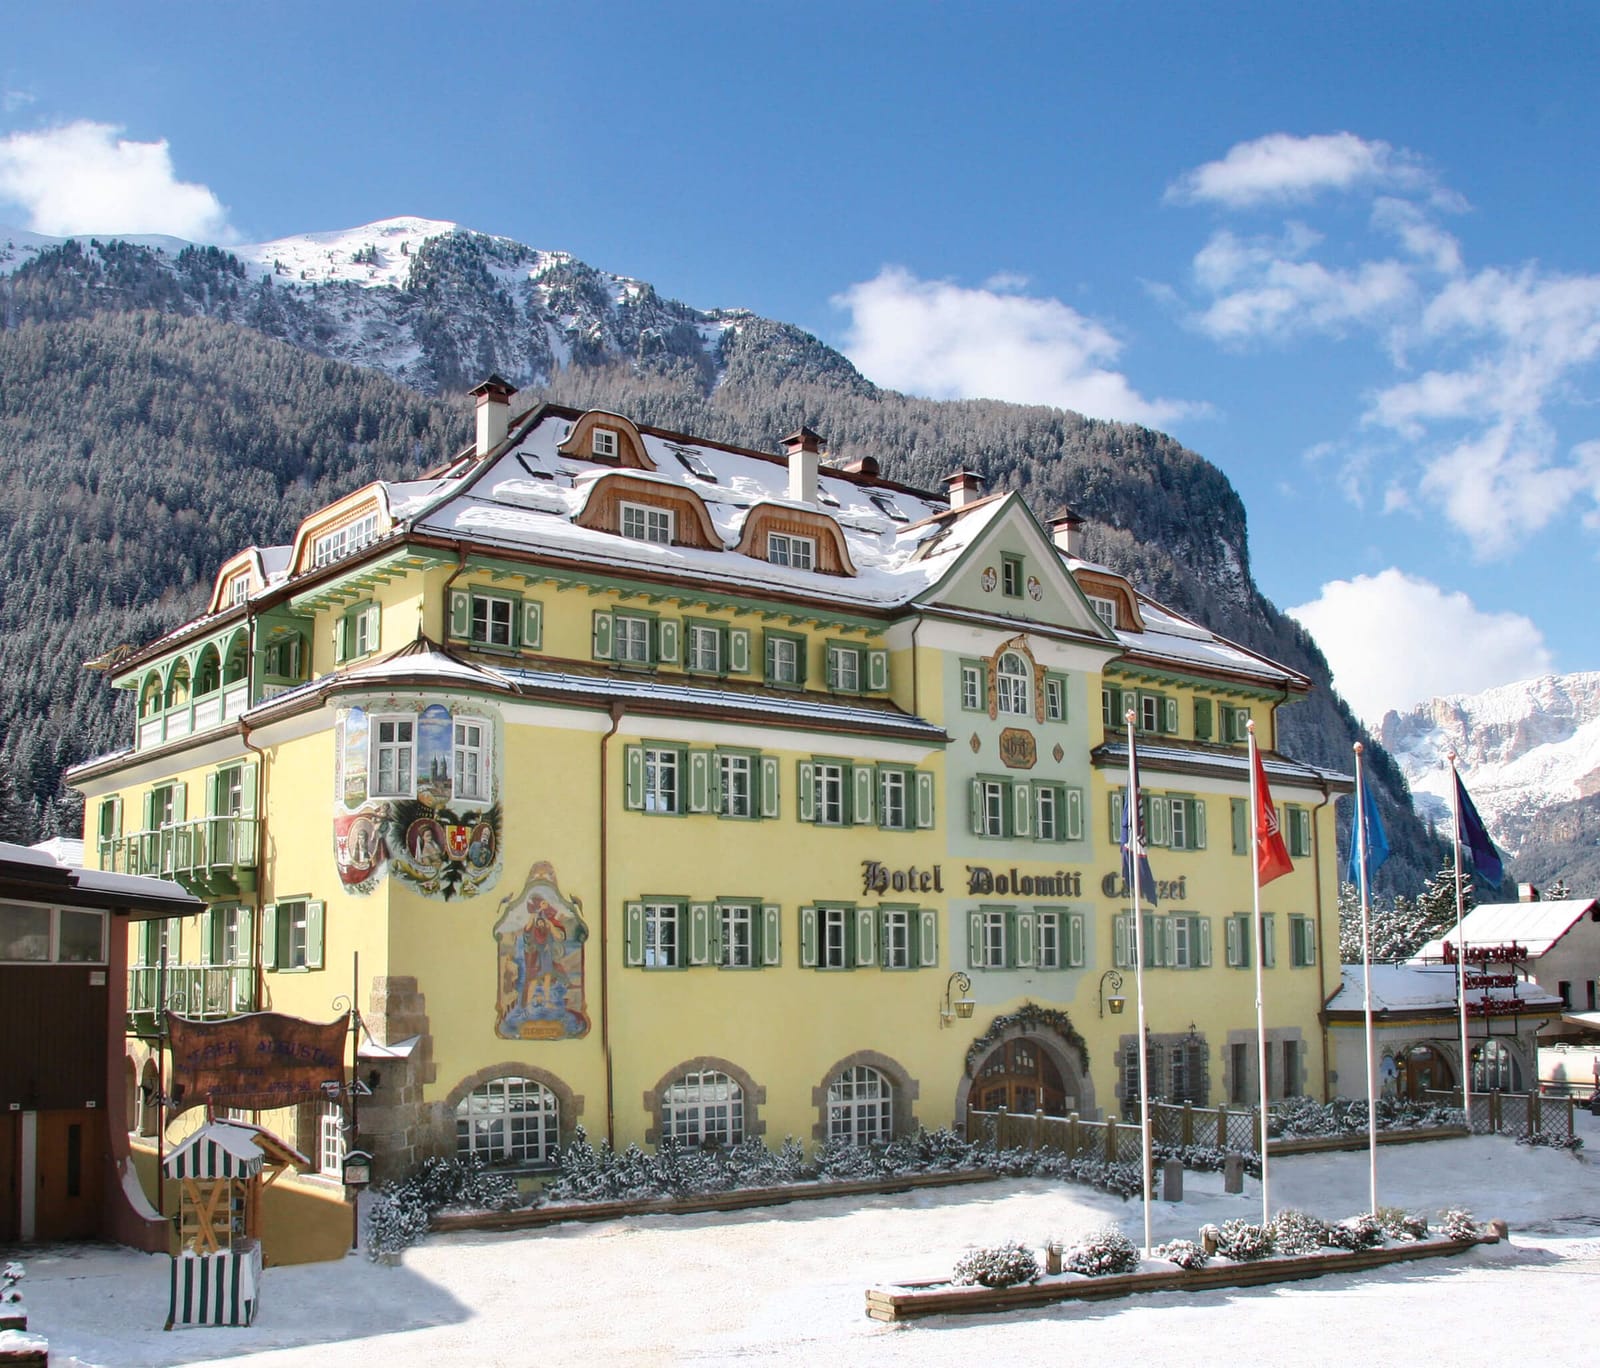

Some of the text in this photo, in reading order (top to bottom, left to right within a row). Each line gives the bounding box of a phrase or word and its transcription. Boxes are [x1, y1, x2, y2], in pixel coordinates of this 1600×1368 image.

[861, 860, 1188, 900] Hotel Dolomiti Cazei
